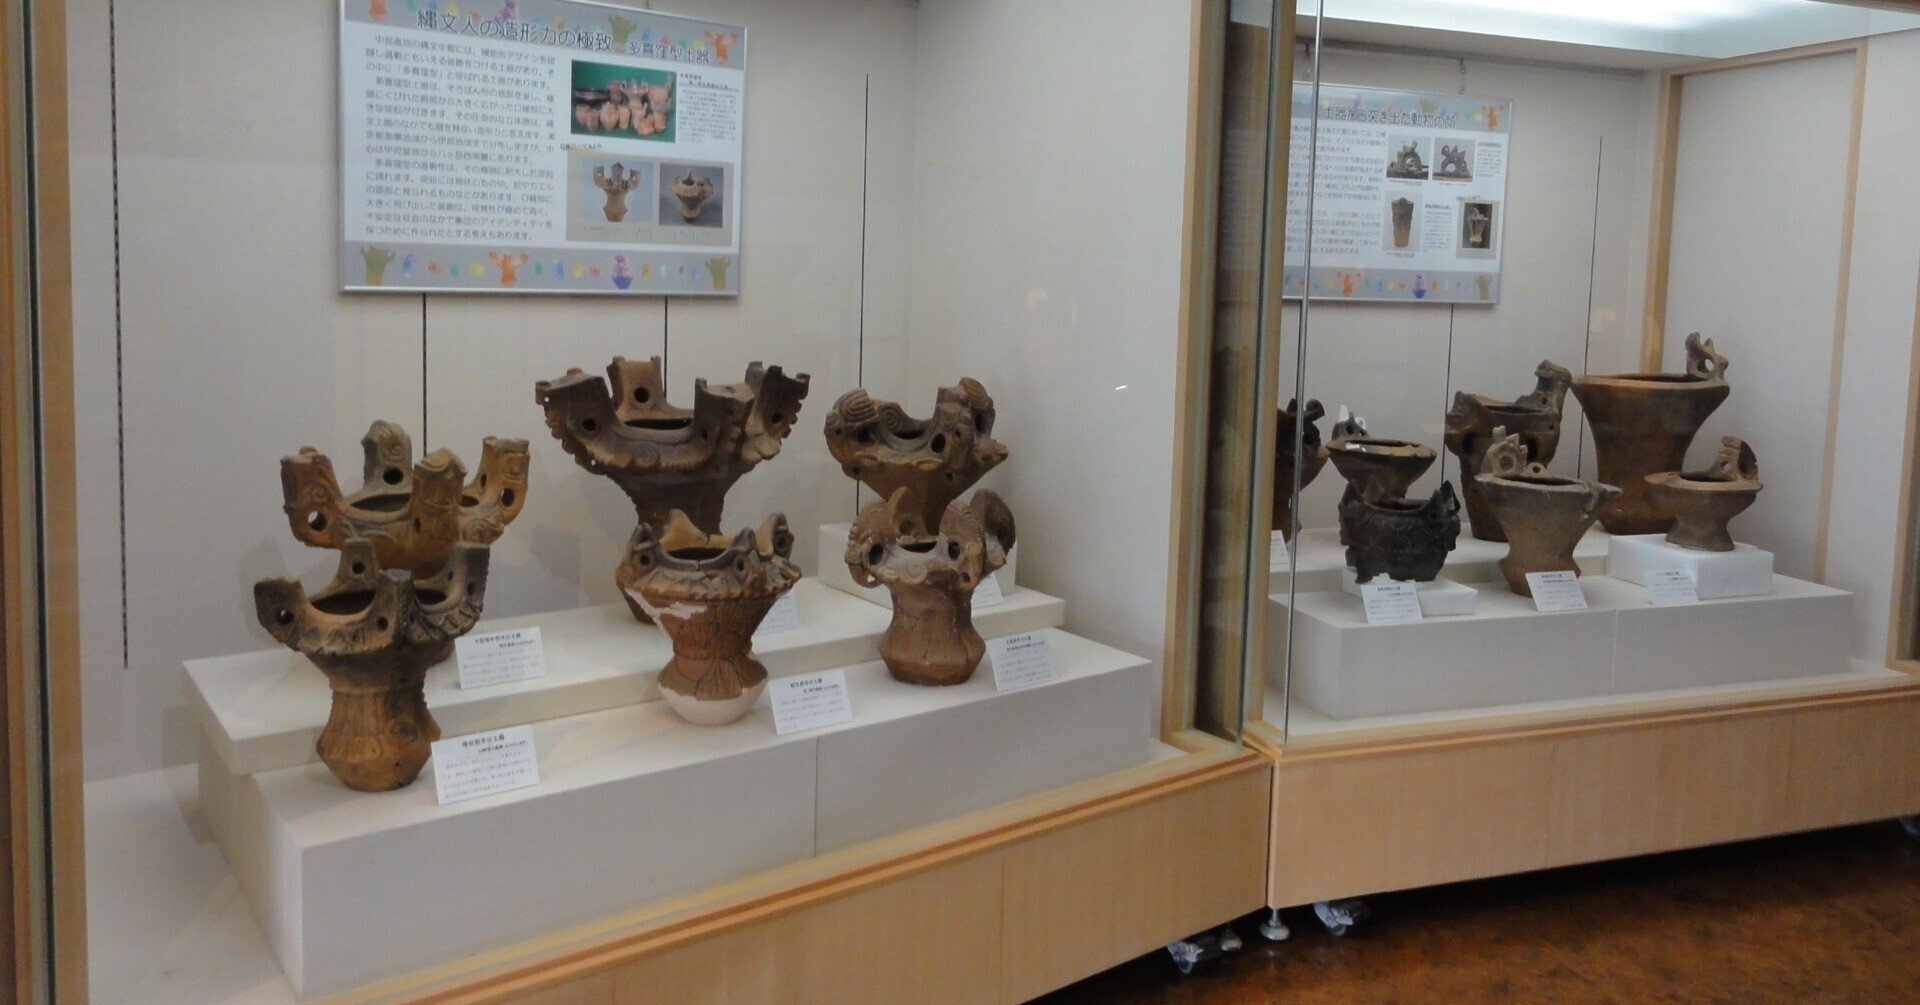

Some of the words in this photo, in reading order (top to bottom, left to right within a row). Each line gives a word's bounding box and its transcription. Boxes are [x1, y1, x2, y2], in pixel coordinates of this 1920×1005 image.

[416, 8, 613, 52] 縄文人の造形力の極致
[629, 41, 710, 64] 多喜窪型土器
